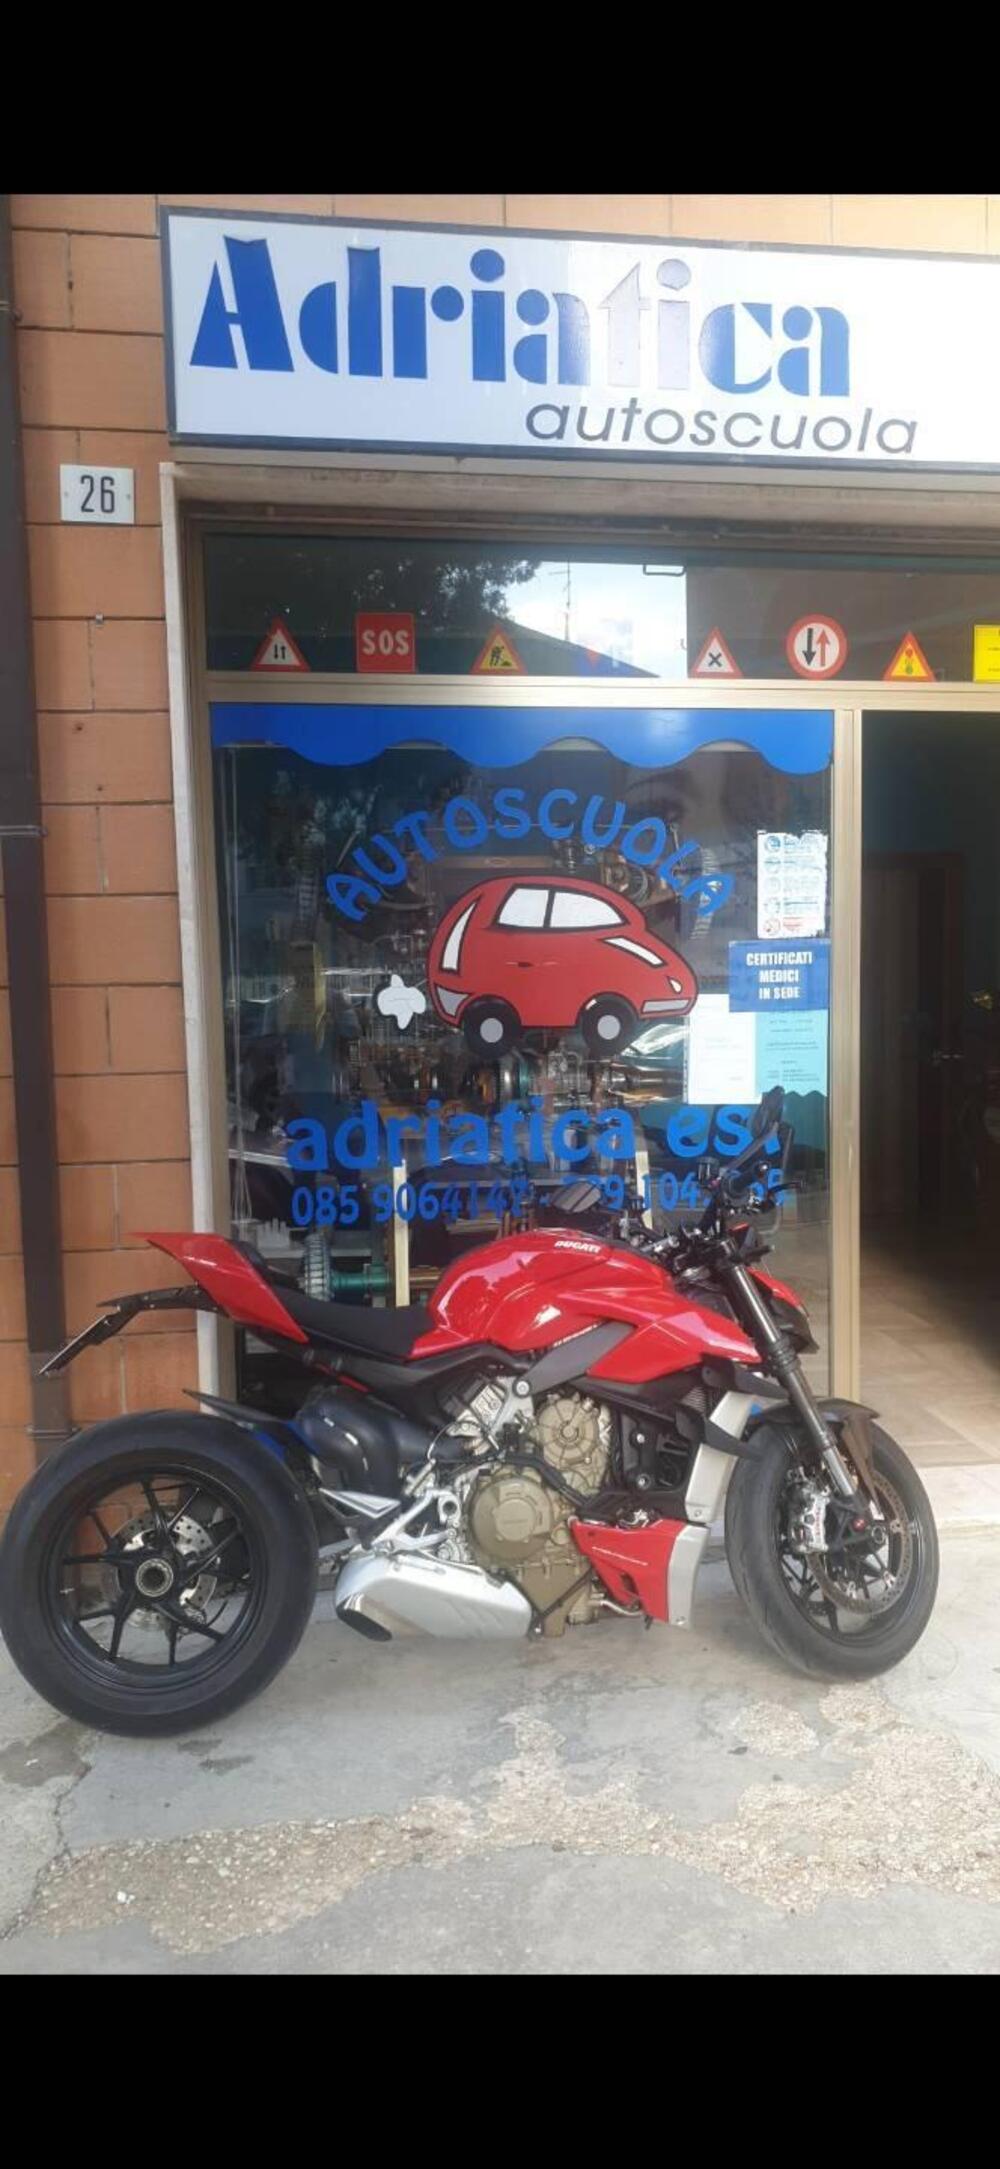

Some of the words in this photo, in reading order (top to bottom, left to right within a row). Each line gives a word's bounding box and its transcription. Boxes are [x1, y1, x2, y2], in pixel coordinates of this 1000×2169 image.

[189, 236, 850, 397] Adriatica
[525, 398, 917, 454] autoscuola
[80, 475, 115, 513] 26
[363, 630, 409, 654] SOS
[325, 788, 736, 923] AUTOSCUOLA
[746, 952, 812, 965] CERTIFICATI
[759, 970, 800, 984] MEDICI
[759, 988, 771, 1000] IN
[774, 987, 801, 999] SEDE
[285, 1097, 636, 1172] adriatica
[291, 1184, 360, 1226] 085
[554, 1240, 601, 1253] DUCATI
